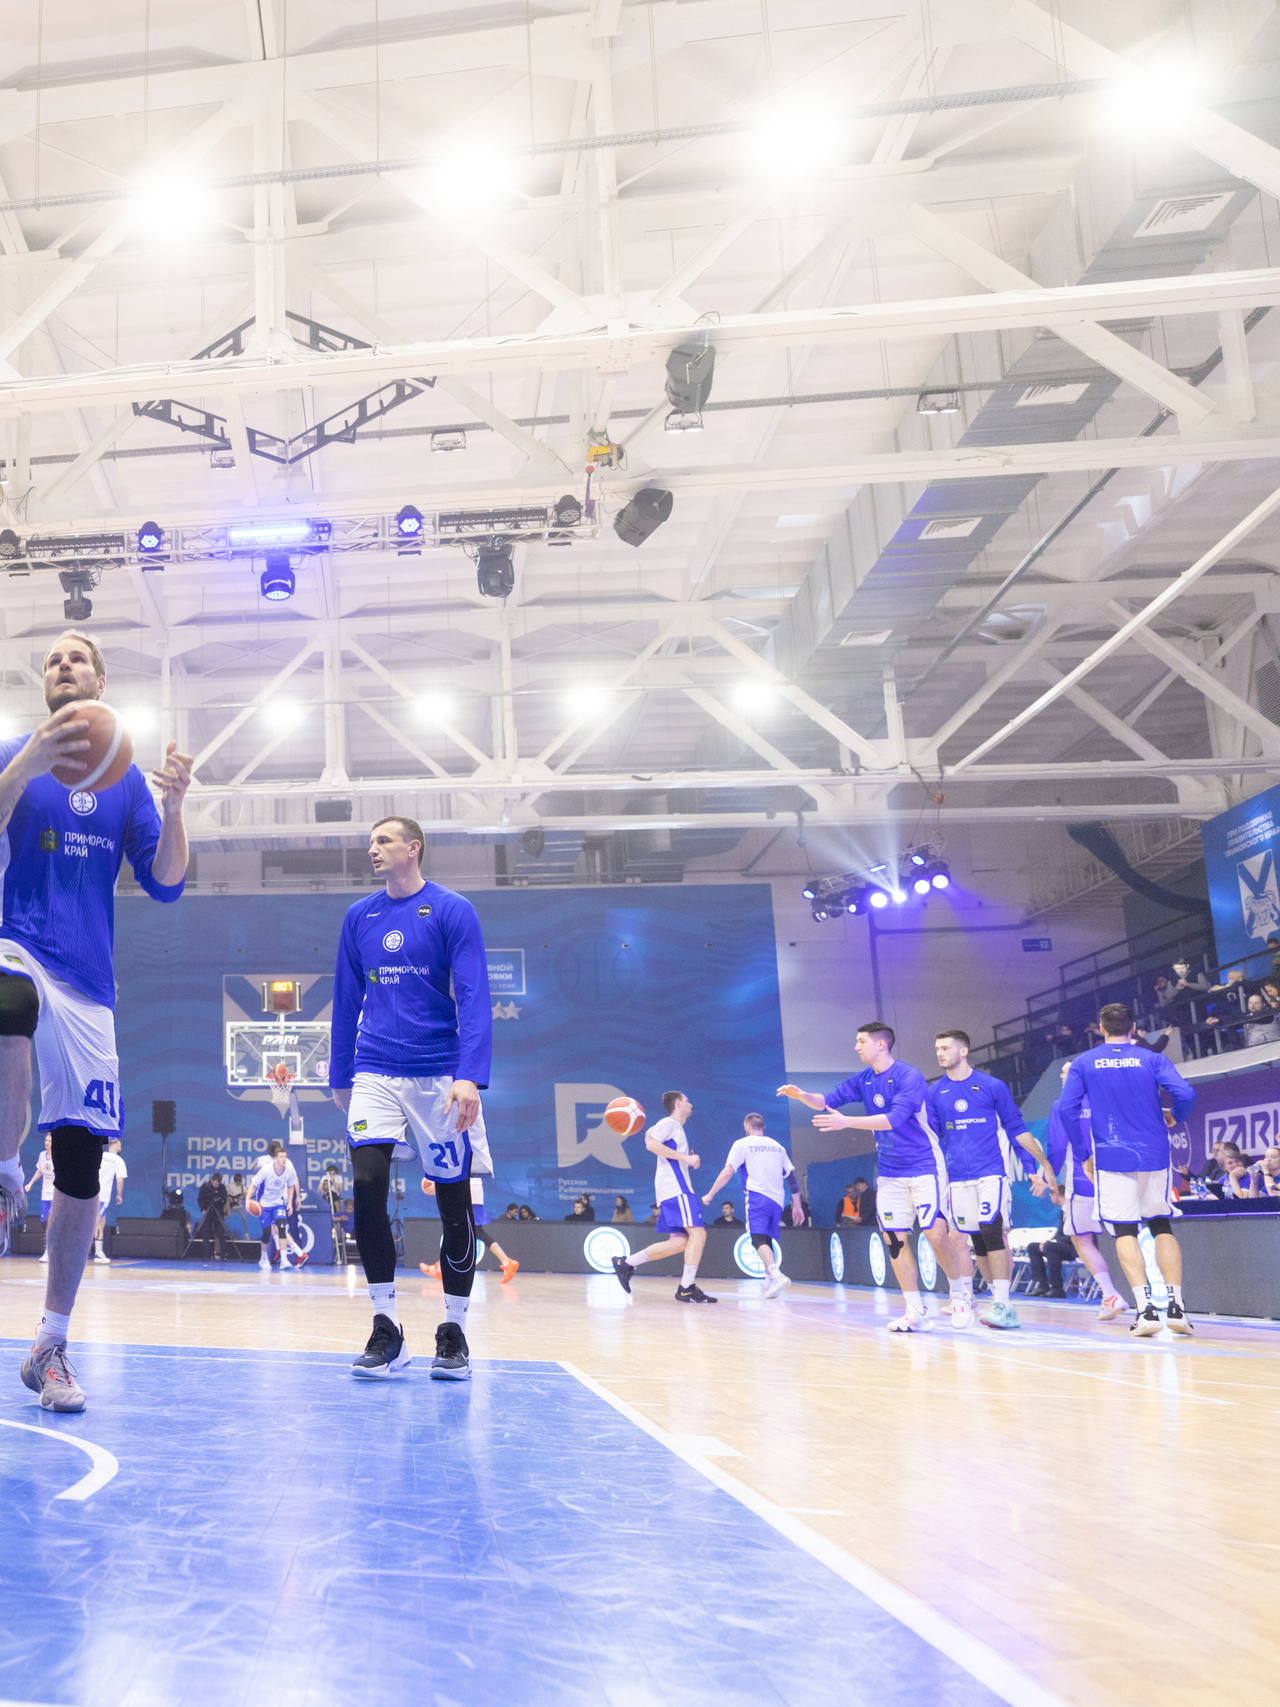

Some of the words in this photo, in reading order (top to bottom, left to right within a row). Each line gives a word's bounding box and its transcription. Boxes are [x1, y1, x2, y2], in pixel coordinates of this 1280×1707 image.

[64, 844, 89, 858] КРАЙ
[379, 965, 430, 975] ПРИМОРСКИЙ
[379, 974, 400, 985] КРАЙ
[262, 1035, 299, 1045] PARI
[1094, 1057, 1142, 1069] СЕМЕНЮК
[84, 1079, 117, 1118] 41
[187, 1137, 229, 1151] ПРИ
[428, 1141, 470, 1169] 21
[980, 1202, 992, 1216] 3
